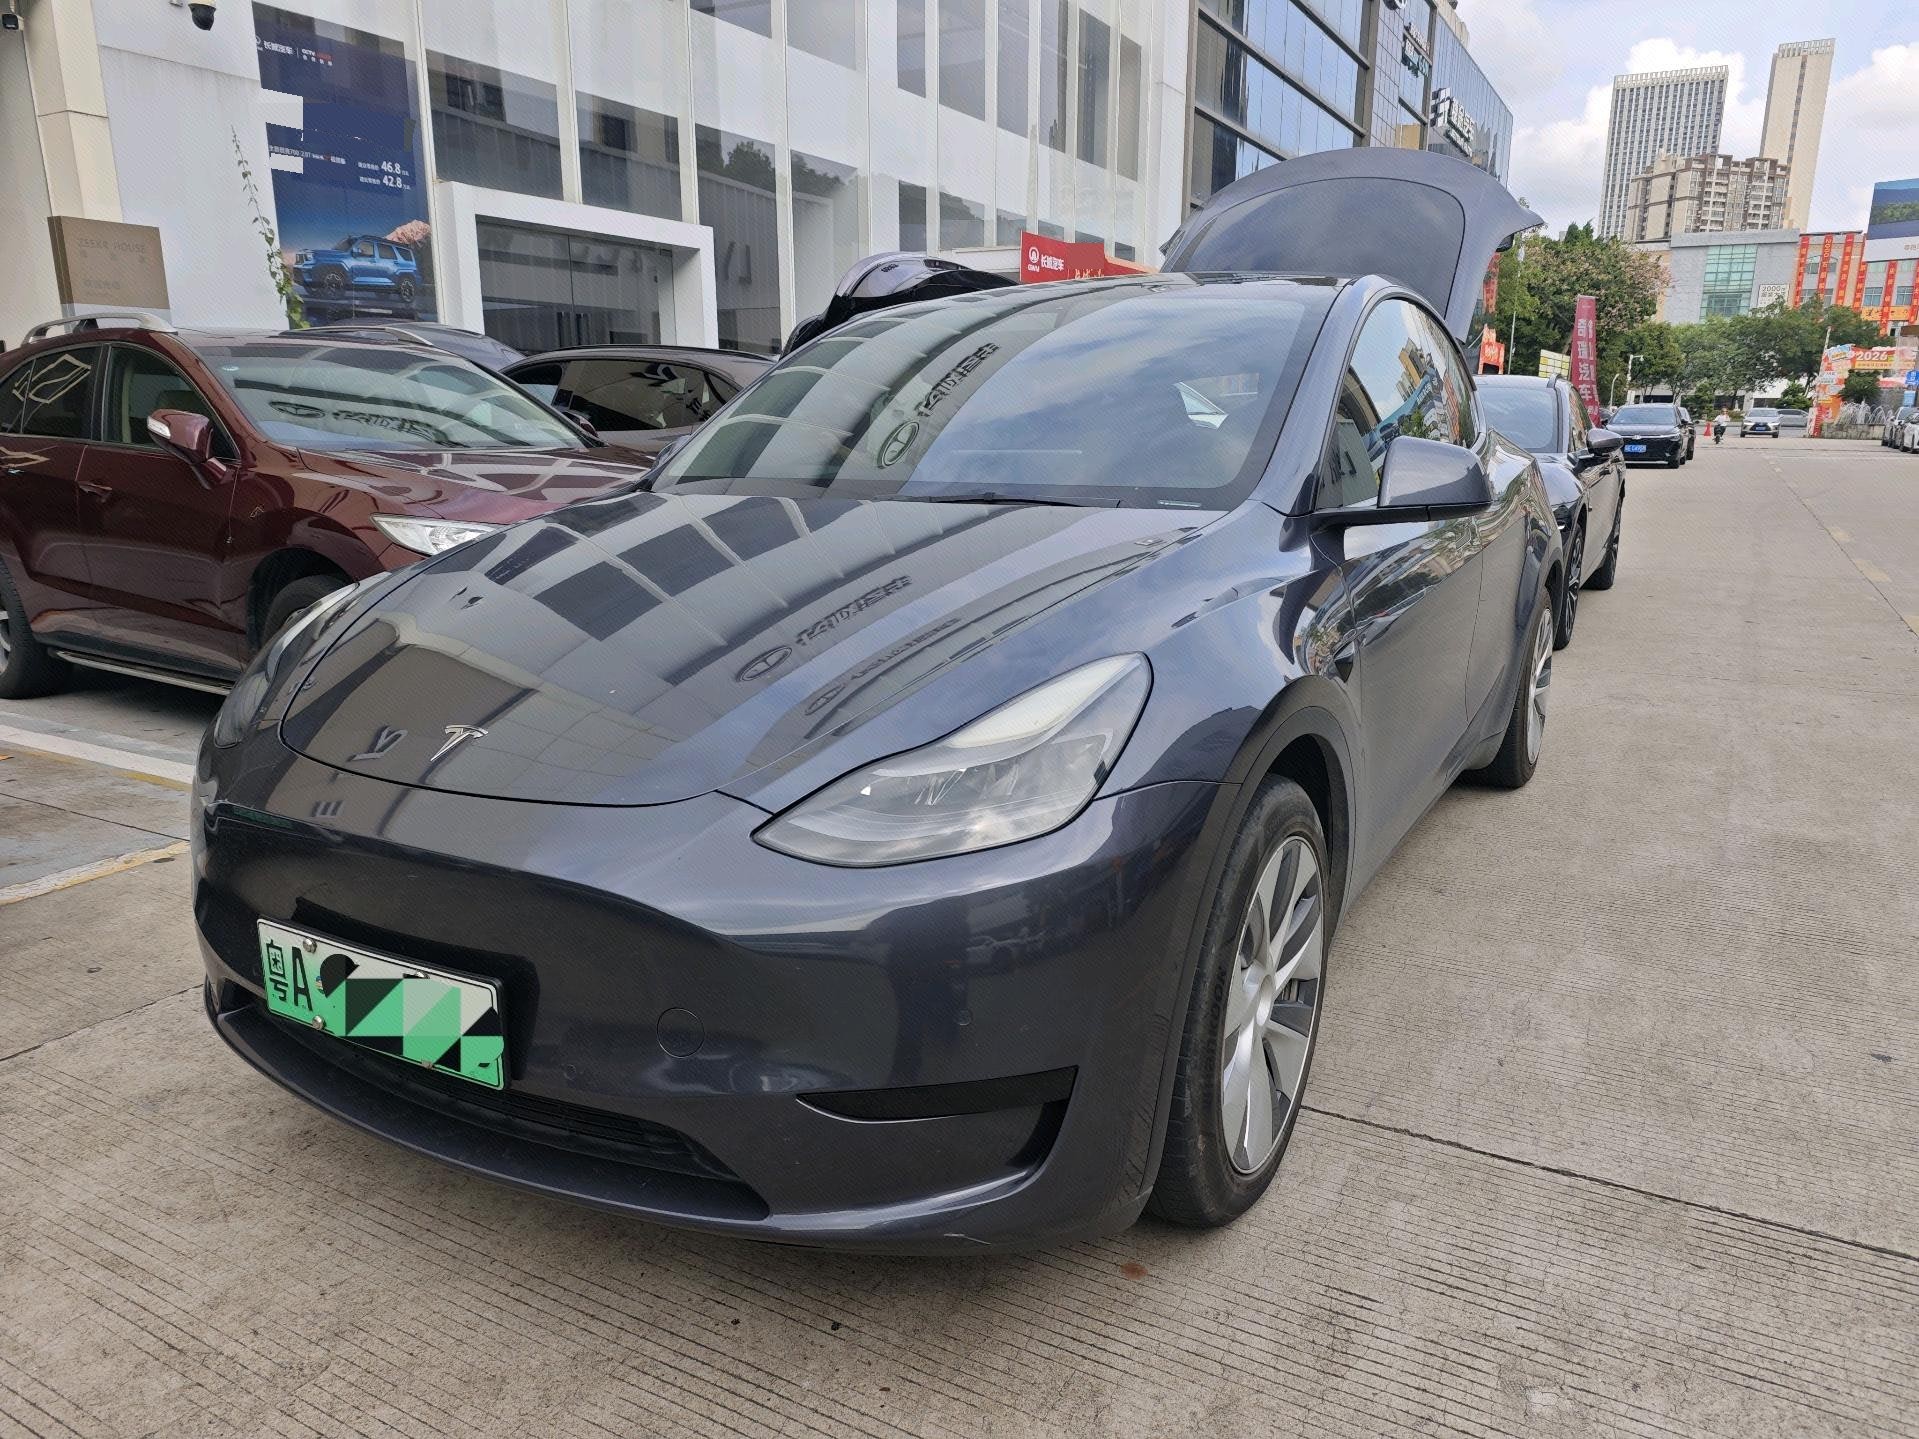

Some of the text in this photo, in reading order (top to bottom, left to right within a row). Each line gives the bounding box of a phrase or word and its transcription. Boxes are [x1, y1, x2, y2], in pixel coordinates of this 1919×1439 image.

[381, 160, 401, 174] 46.8
[382, 175, 403, 189] 42.8
[112, 241, 145, 253] HOUSE
[1041, 254, 1064, 271] 长城汽车
[1577, 319, 1592, 401] 奇瑞汽车
[1856, 351, 1888, 361] 2026
